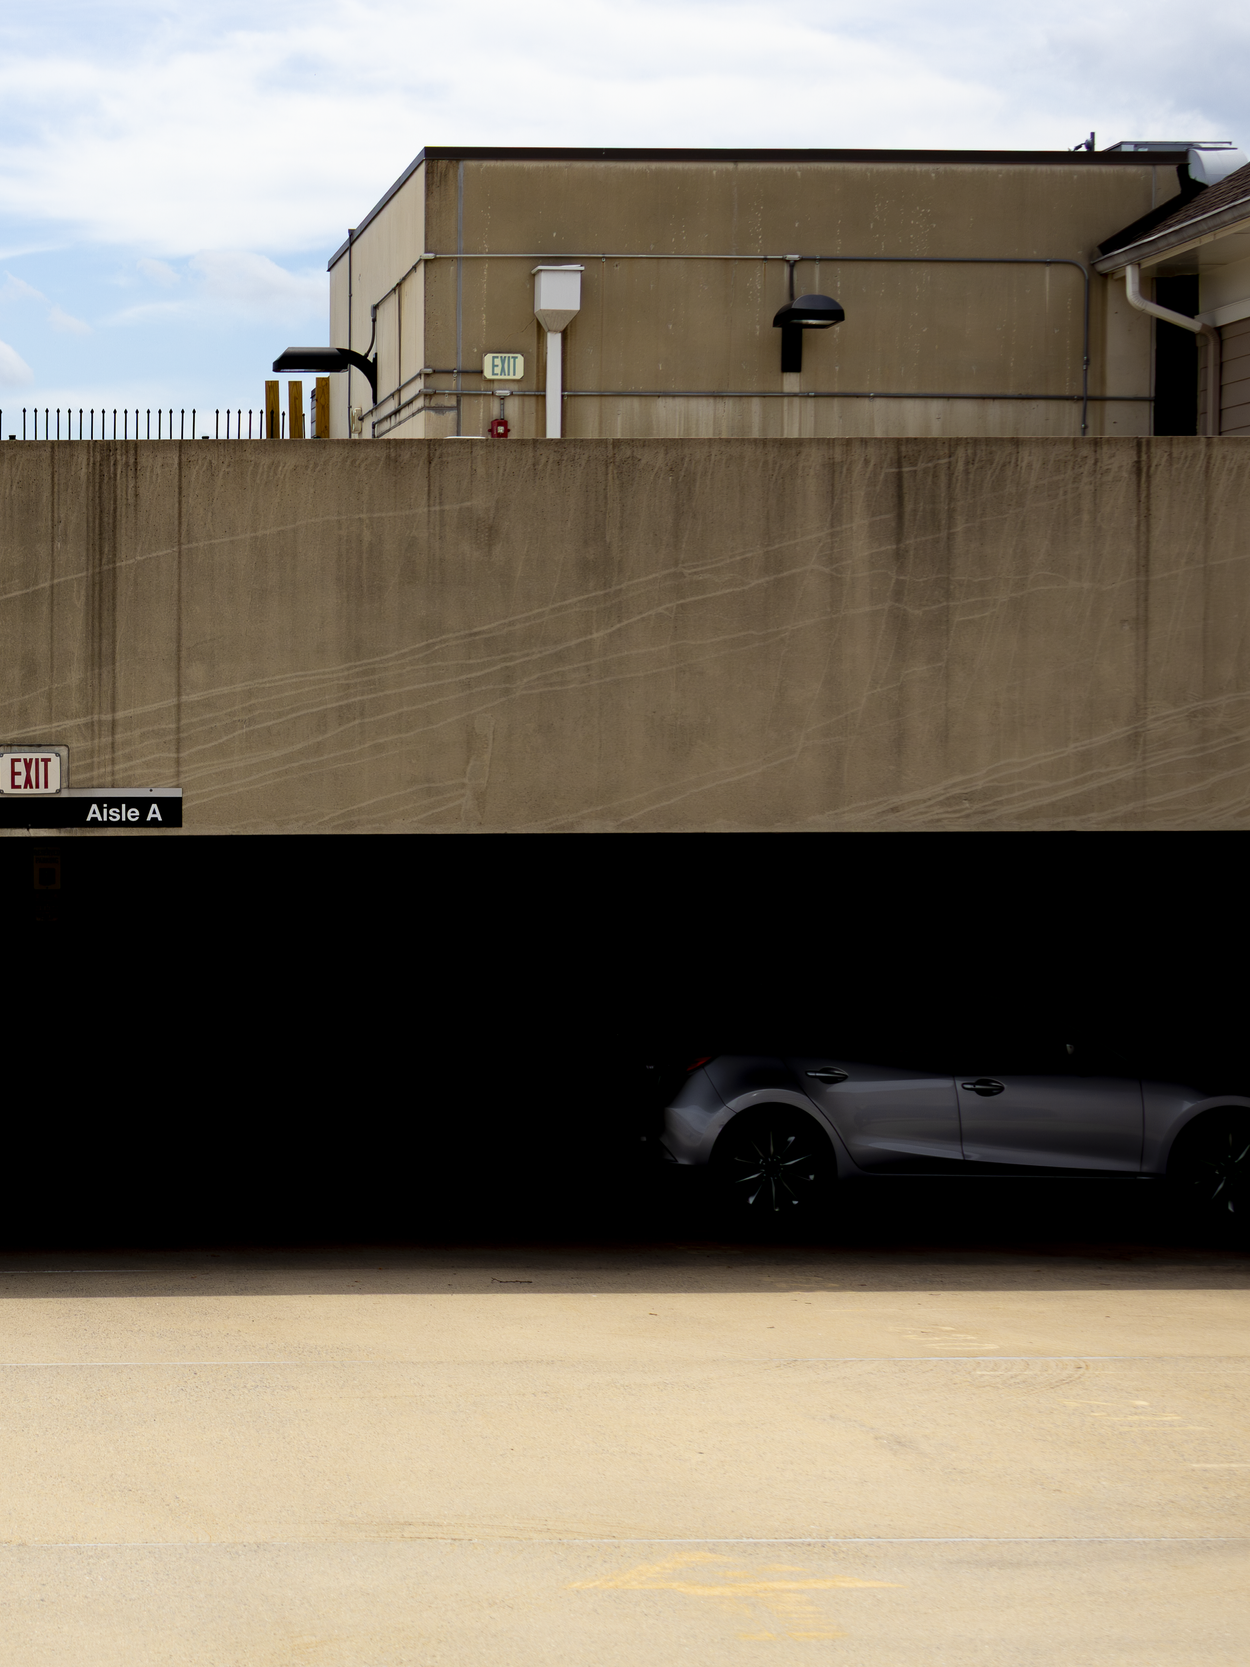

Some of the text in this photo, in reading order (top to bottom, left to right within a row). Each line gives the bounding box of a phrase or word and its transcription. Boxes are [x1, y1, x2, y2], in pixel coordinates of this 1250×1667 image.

[491, 355, 518, 376] EXIT
[10, 757, 52, 789] EXIT
[86, 803, 162, 822] Aisle A
